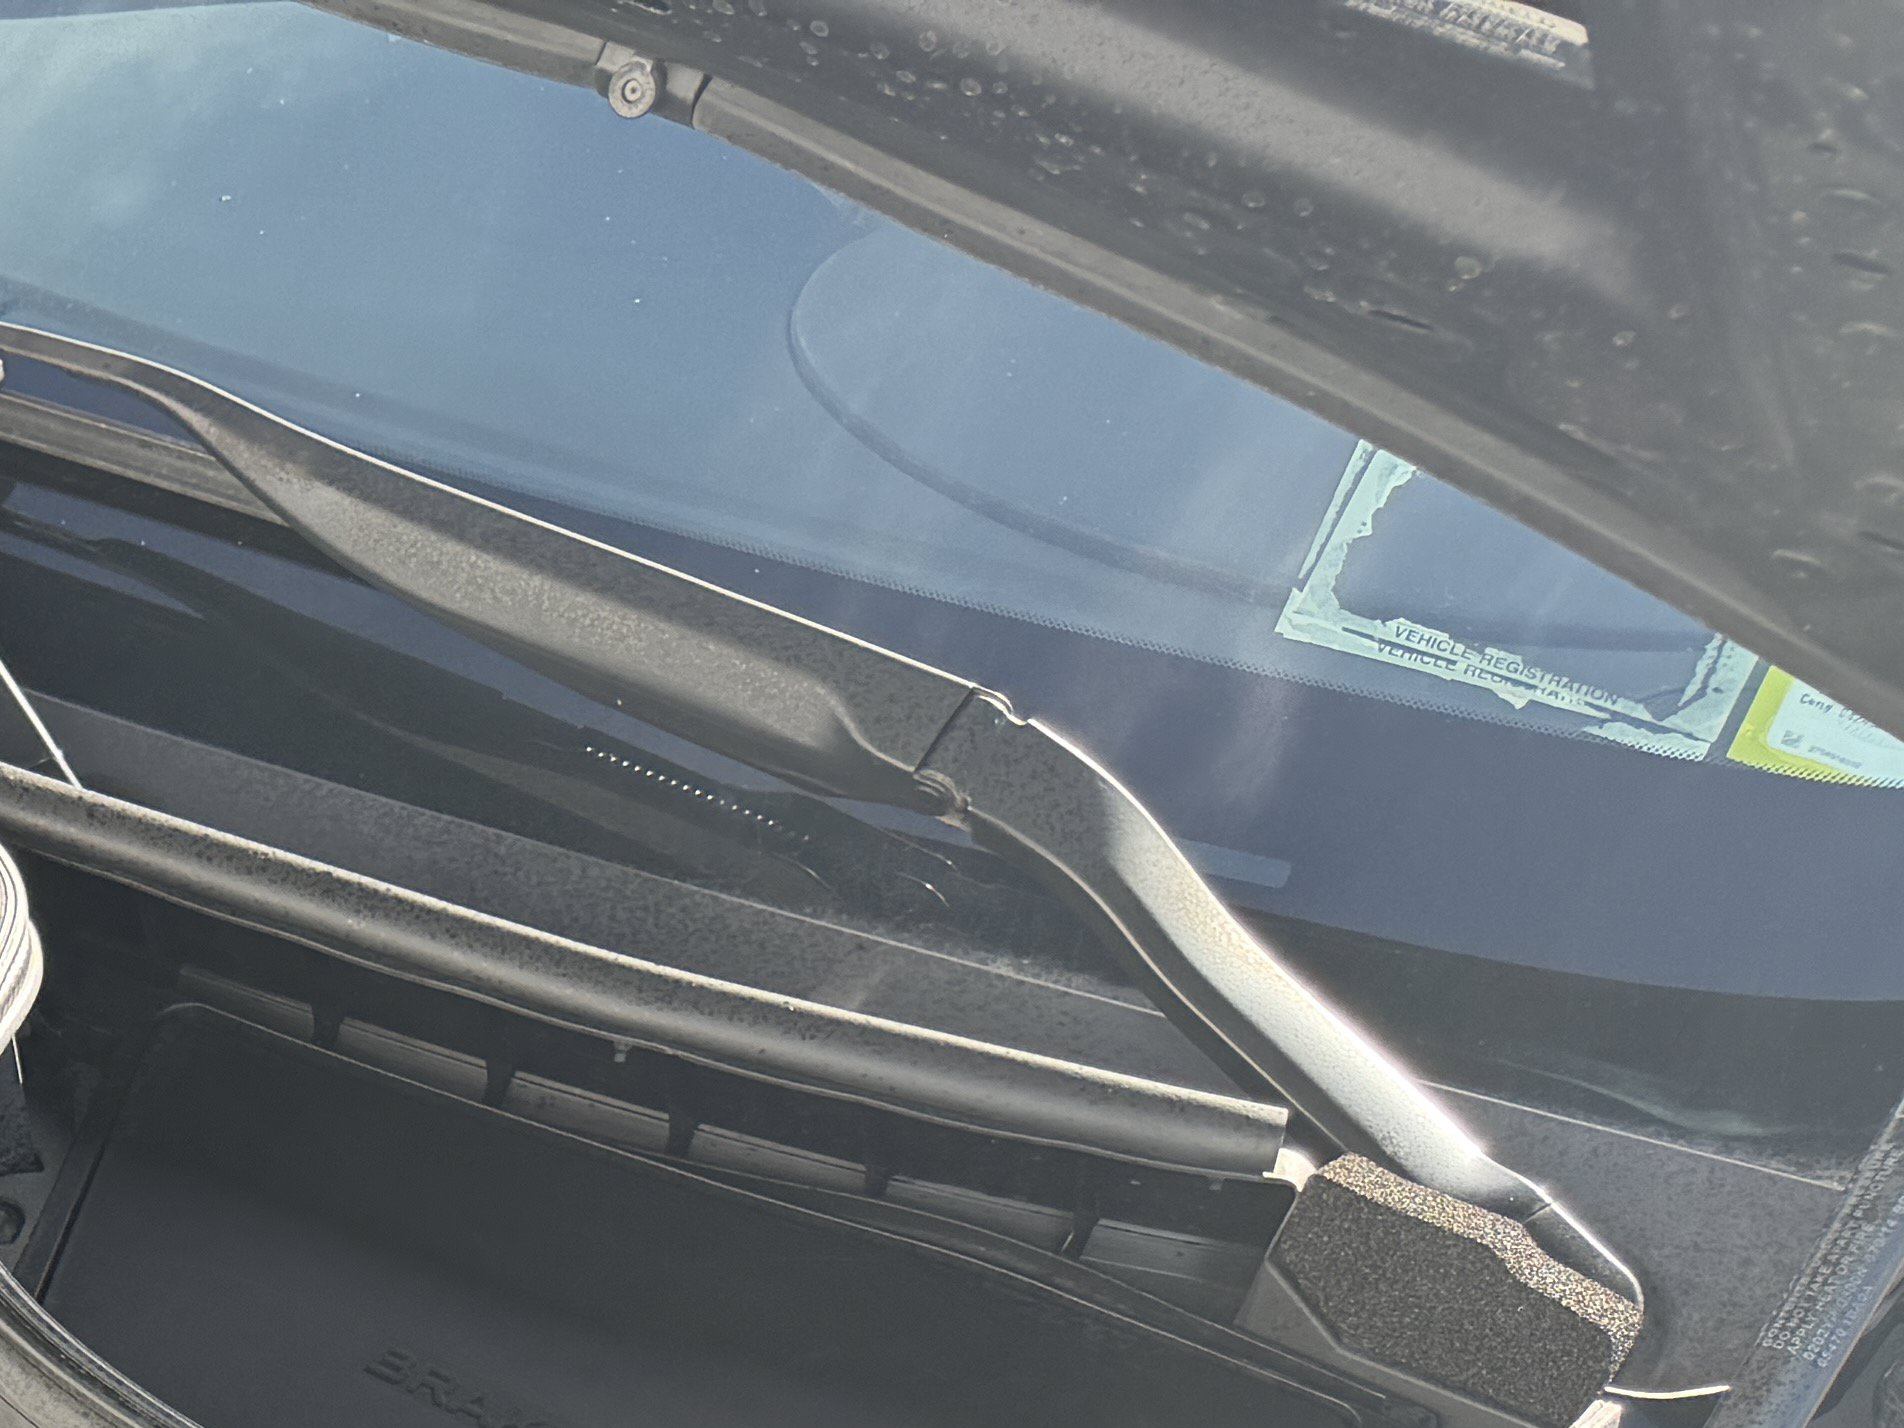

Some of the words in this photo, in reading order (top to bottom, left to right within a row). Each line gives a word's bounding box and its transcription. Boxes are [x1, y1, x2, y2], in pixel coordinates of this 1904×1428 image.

[1394, 625, 1472, 660] VEHICLE
[1478, 651, 1620, 706] REGISTRATION
[1786, 1312, 1818, 1356] APPLY
[1813, 1276, 1840, 1311] HEAT
[1835, 1253, 1854, 1275] OR
[1806, 1264, 1832, 1299] TAKE
